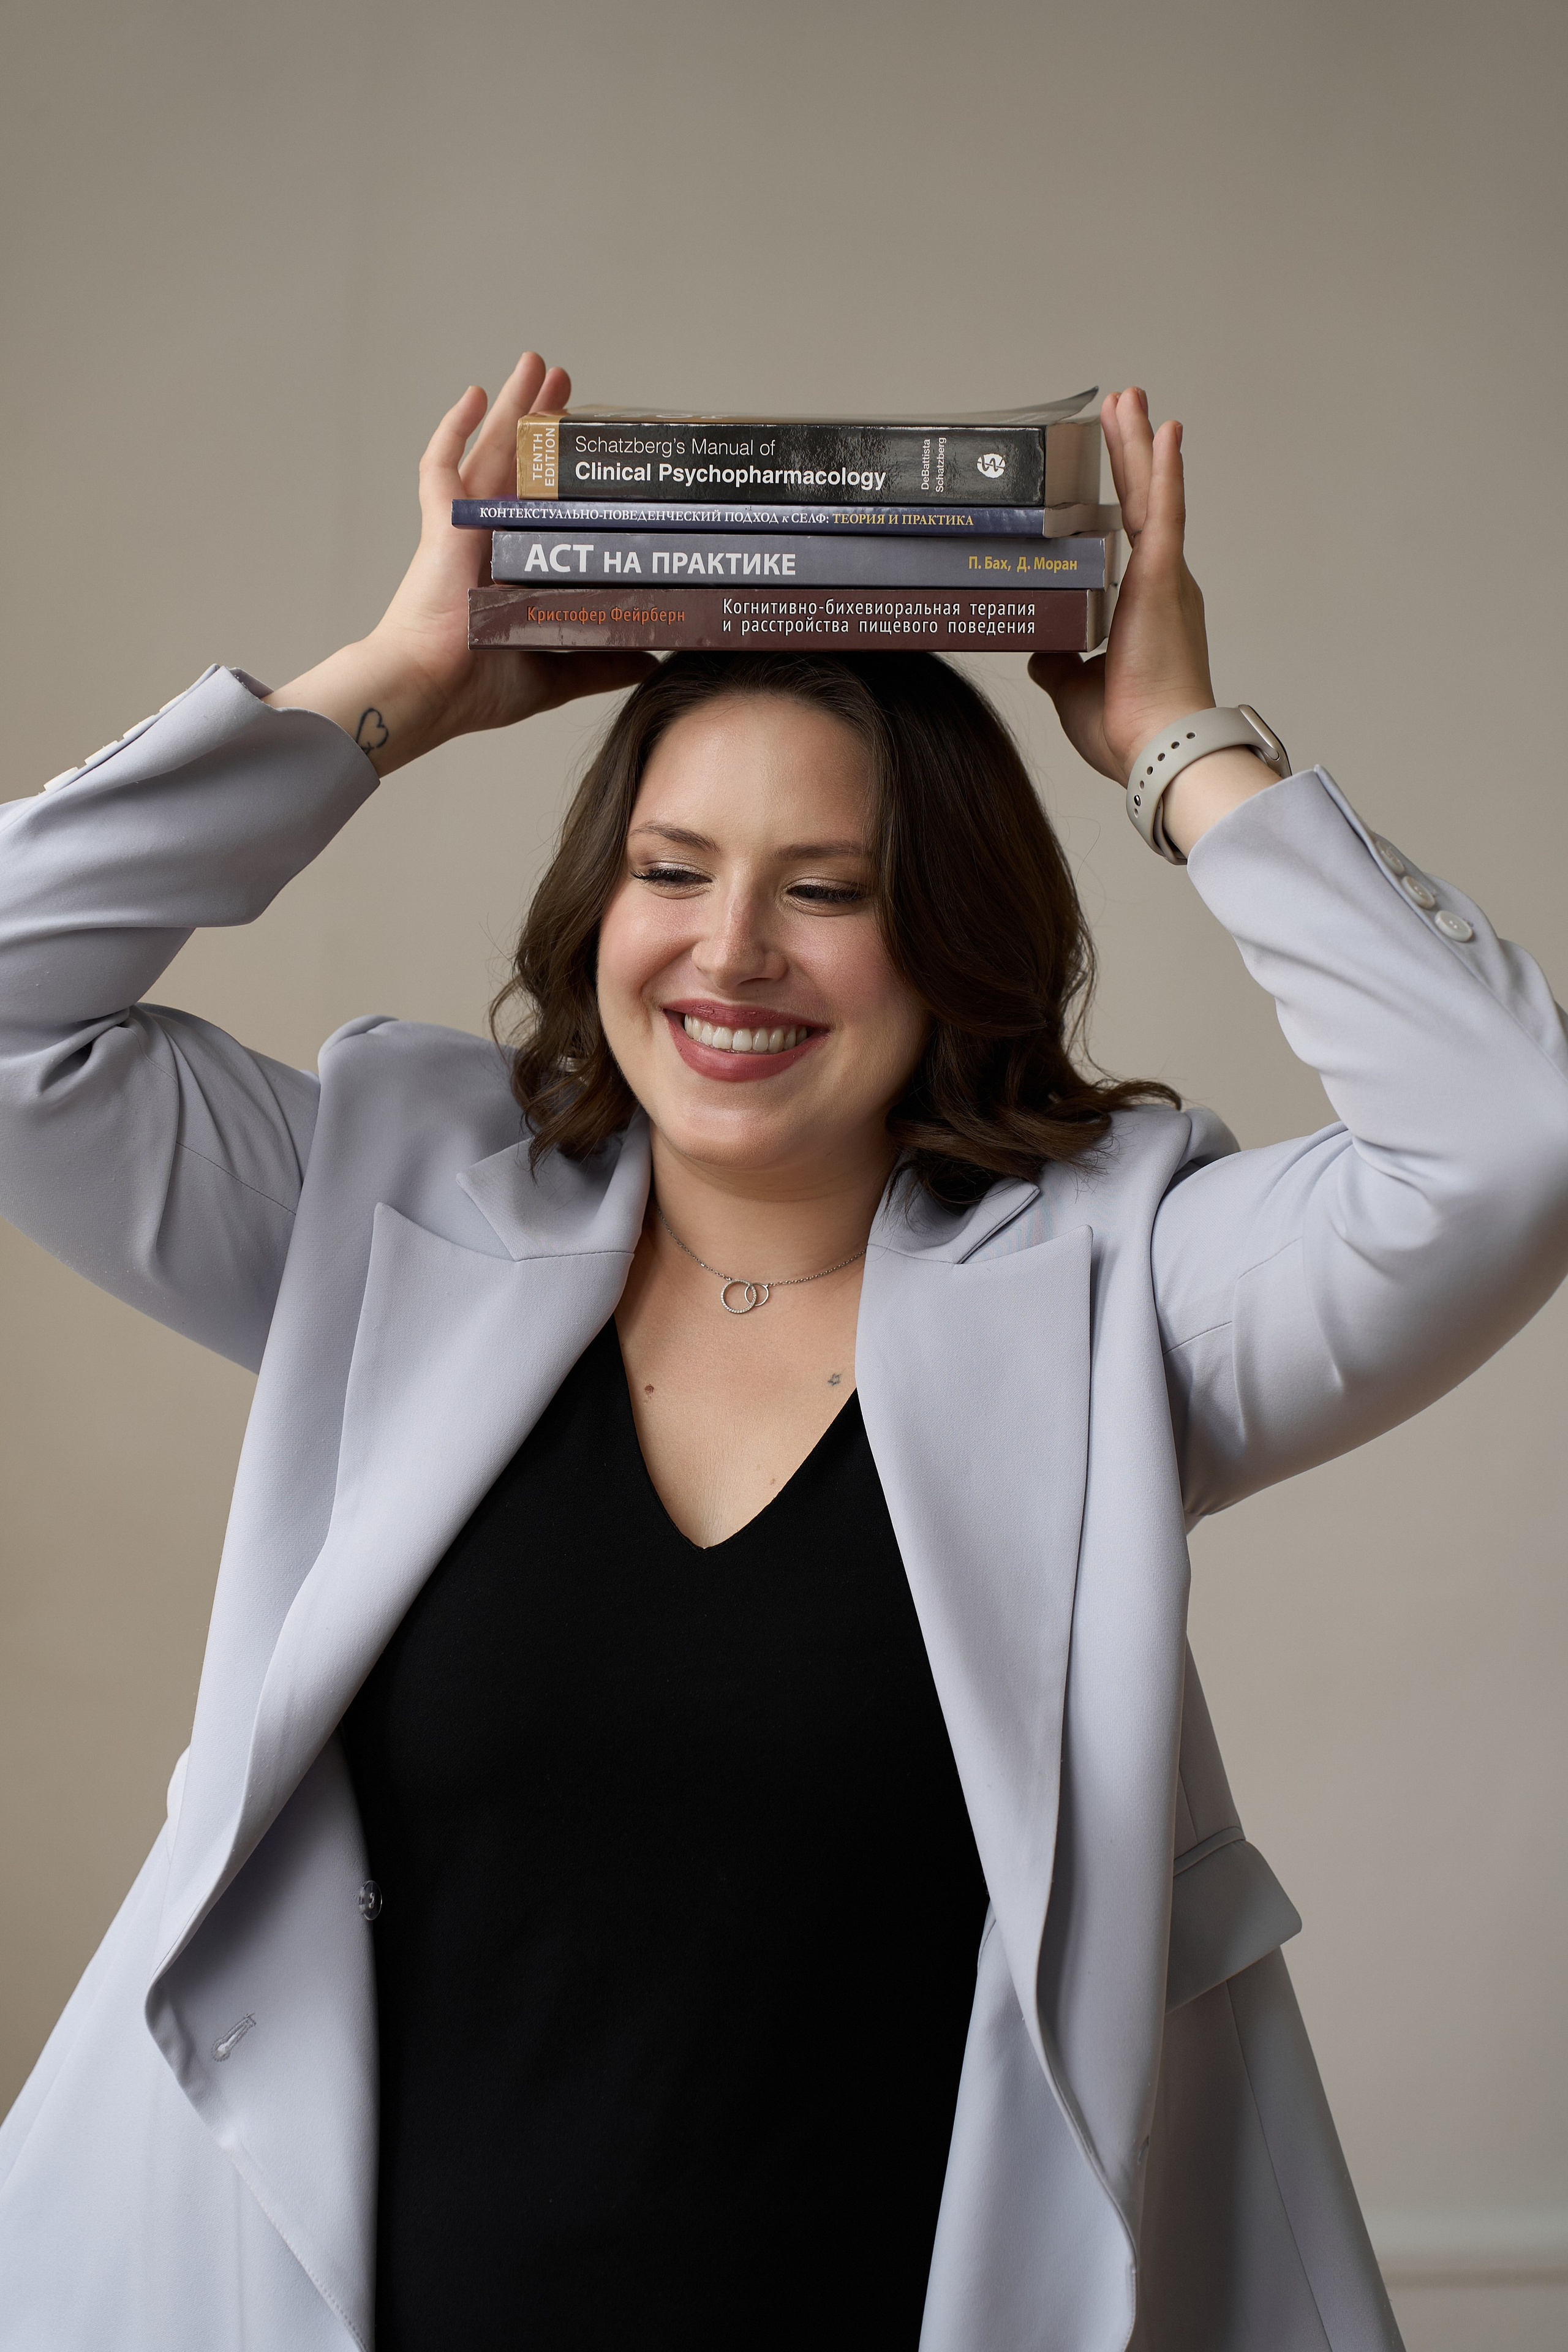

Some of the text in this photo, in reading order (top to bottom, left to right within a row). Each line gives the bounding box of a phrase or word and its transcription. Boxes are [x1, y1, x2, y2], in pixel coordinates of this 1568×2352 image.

[532, 432, 543, 481] TENTH
[545, 428, 556, 487] EDITION
[691, 439, 754, 456] Manual
[759, 439, 776, 456] of
[575, 461, 886, 491] Clinical Psychopharmacology
[921, 439, 931, 491] DeBattista
[935, 437, 947, 493] Schatzberg
[479, 507, 722, 523] КОНТЕКСТУАЛЬНО-ПОВЕДЕНЧЕСКИЙ
[724, 511, 779, 524] ПОДХОД
[791, 512, 829, 524] СЕЛФ:
[832, 513, 884, 524] ТЕОРИЯ
[888, 514, 899, 525] И
[902, 514, 974, 526] ПРАКТИКА
[603, 551, 642, 573] НА
[652, 552, 796, 575] ПРАКТИКЕ
[968, 556, 1077, 572] П. Бах, Д. Моран
[527, 606, 685, 624] Кристофер Фейрберн
[723, 598, 1036, 619] Когнитивно-бихевиоральная терапия
[723, 617, 1036, 636] и расстройства пищевого поведения
